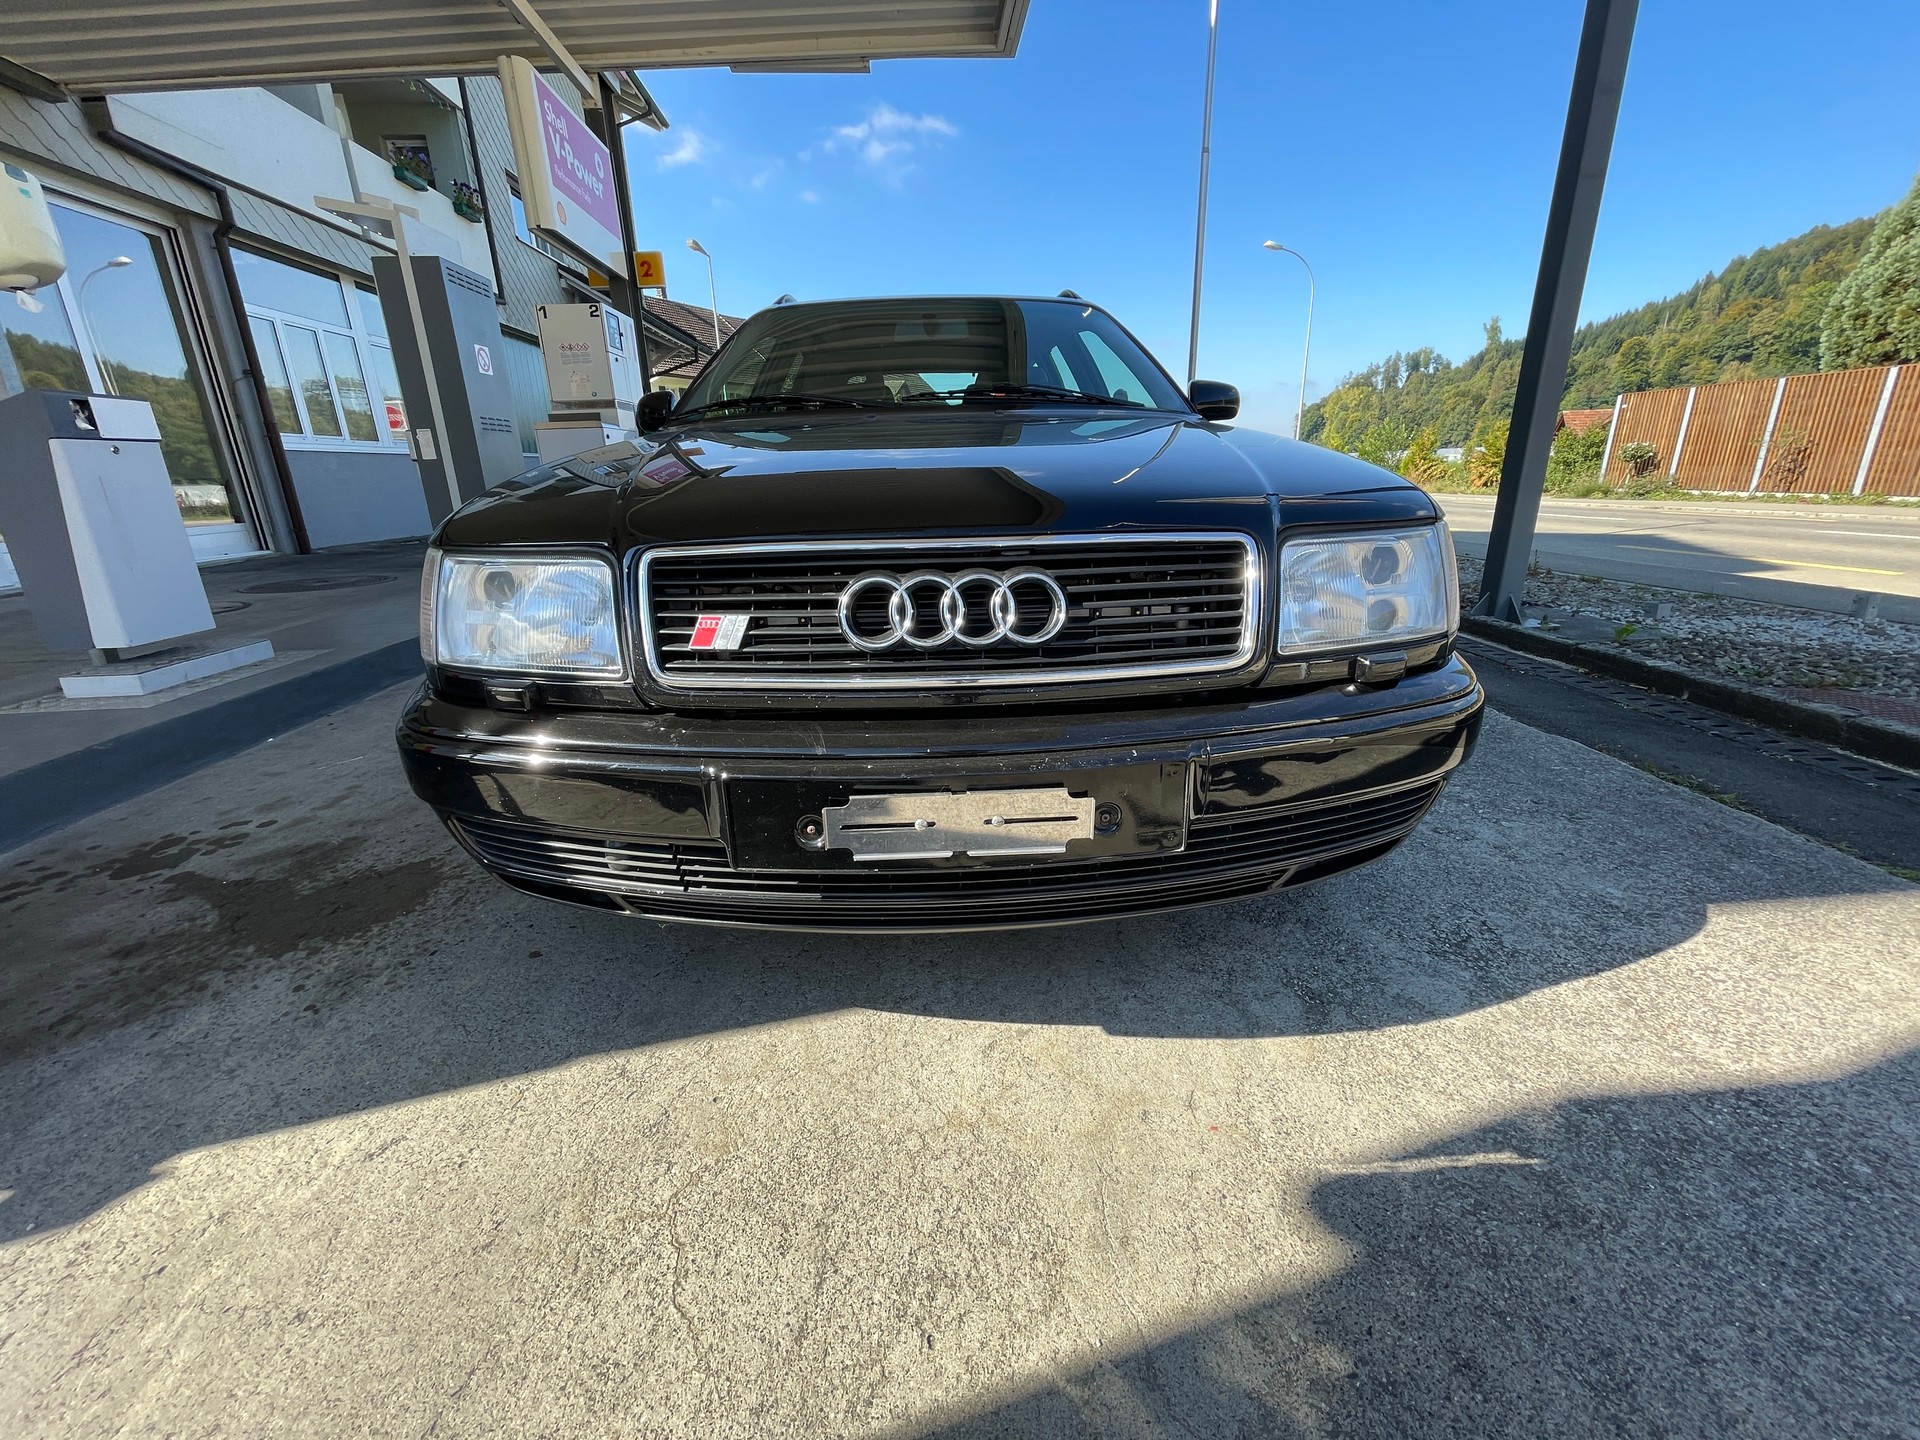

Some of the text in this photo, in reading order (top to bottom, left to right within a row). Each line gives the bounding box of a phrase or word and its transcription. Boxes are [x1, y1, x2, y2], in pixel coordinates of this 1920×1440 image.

[543, 99, 568, 139] Shell
[548, 126, 604, 200] V-Power
[640, 260, 653, 278] 2
[538, 304, 600, 319] 1 2
